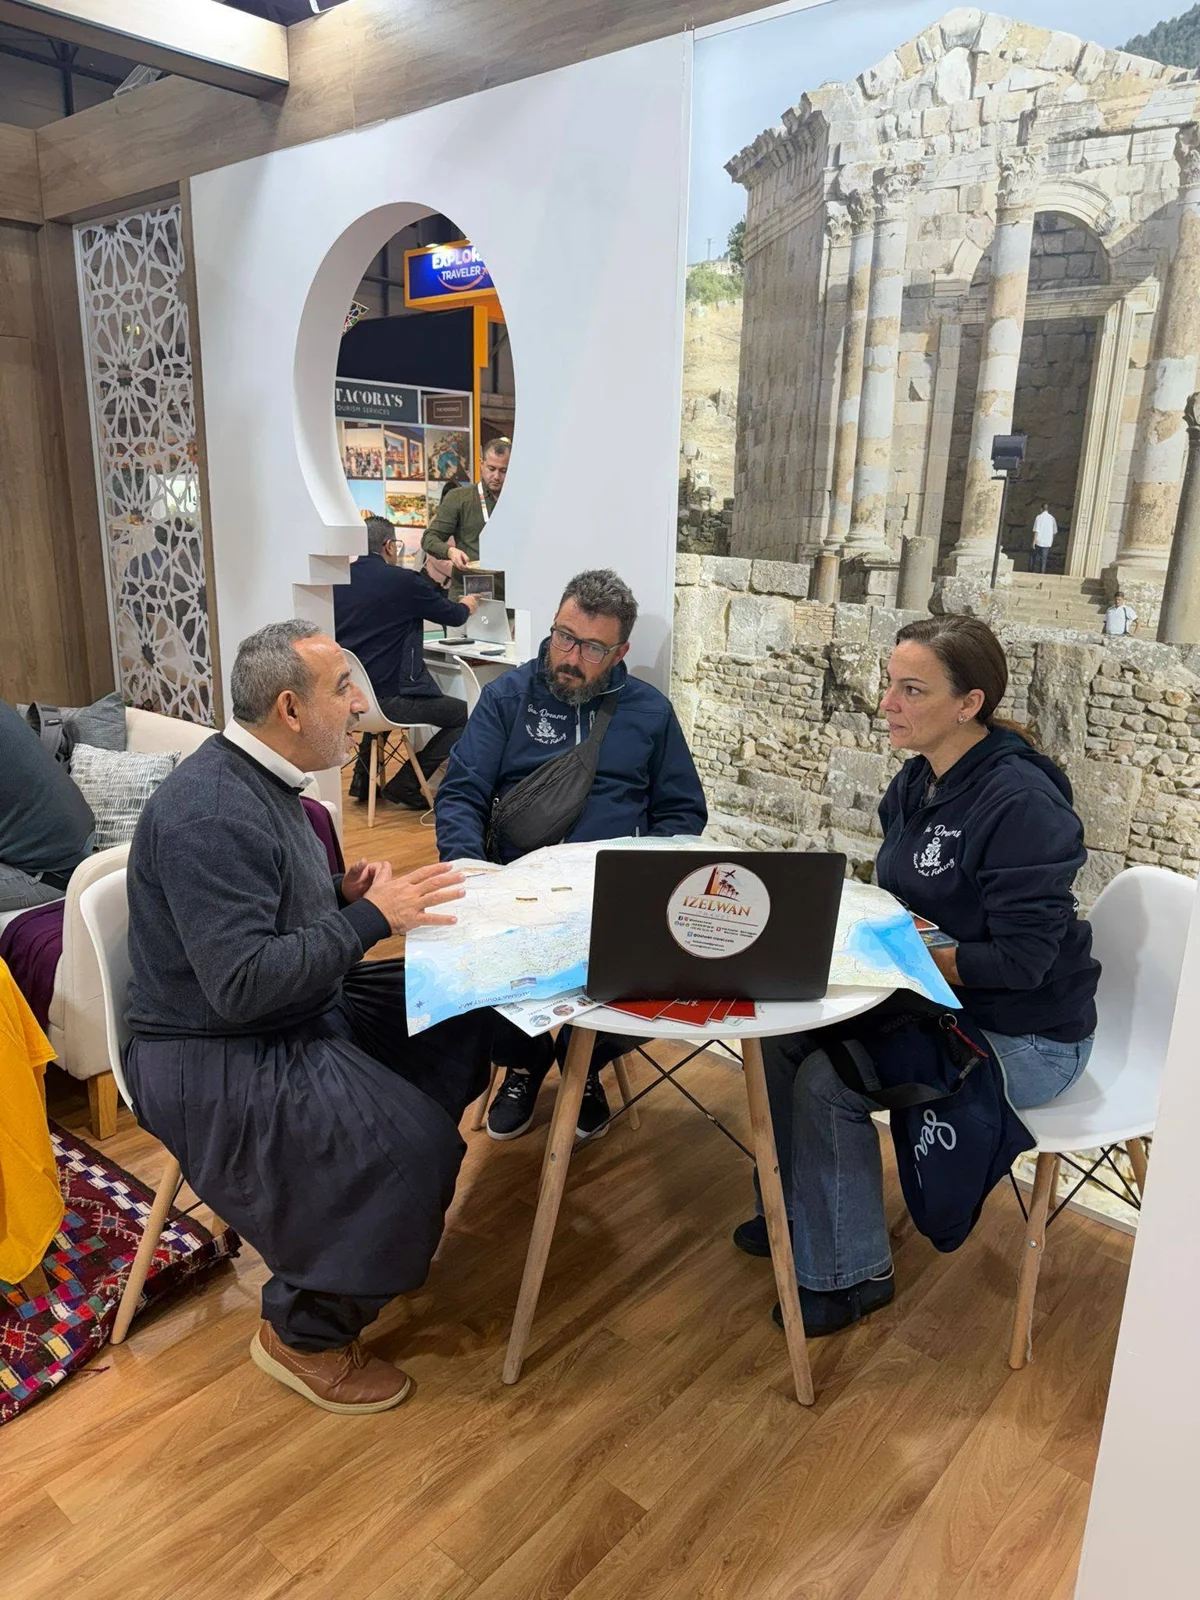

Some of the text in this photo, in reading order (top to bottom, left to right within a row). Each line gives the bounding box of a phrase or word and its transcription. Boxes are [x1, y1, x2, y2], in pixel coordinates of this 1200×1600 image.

[432, 247, 483, 270] EXPLOR
[441, 265, 481, 281] TRAVELER
[336, 404, 390, 416] OURISM SERVICES
[682, 895, 752, 917] IZELWAN
[914, 1108, 957, 1162] Sea
